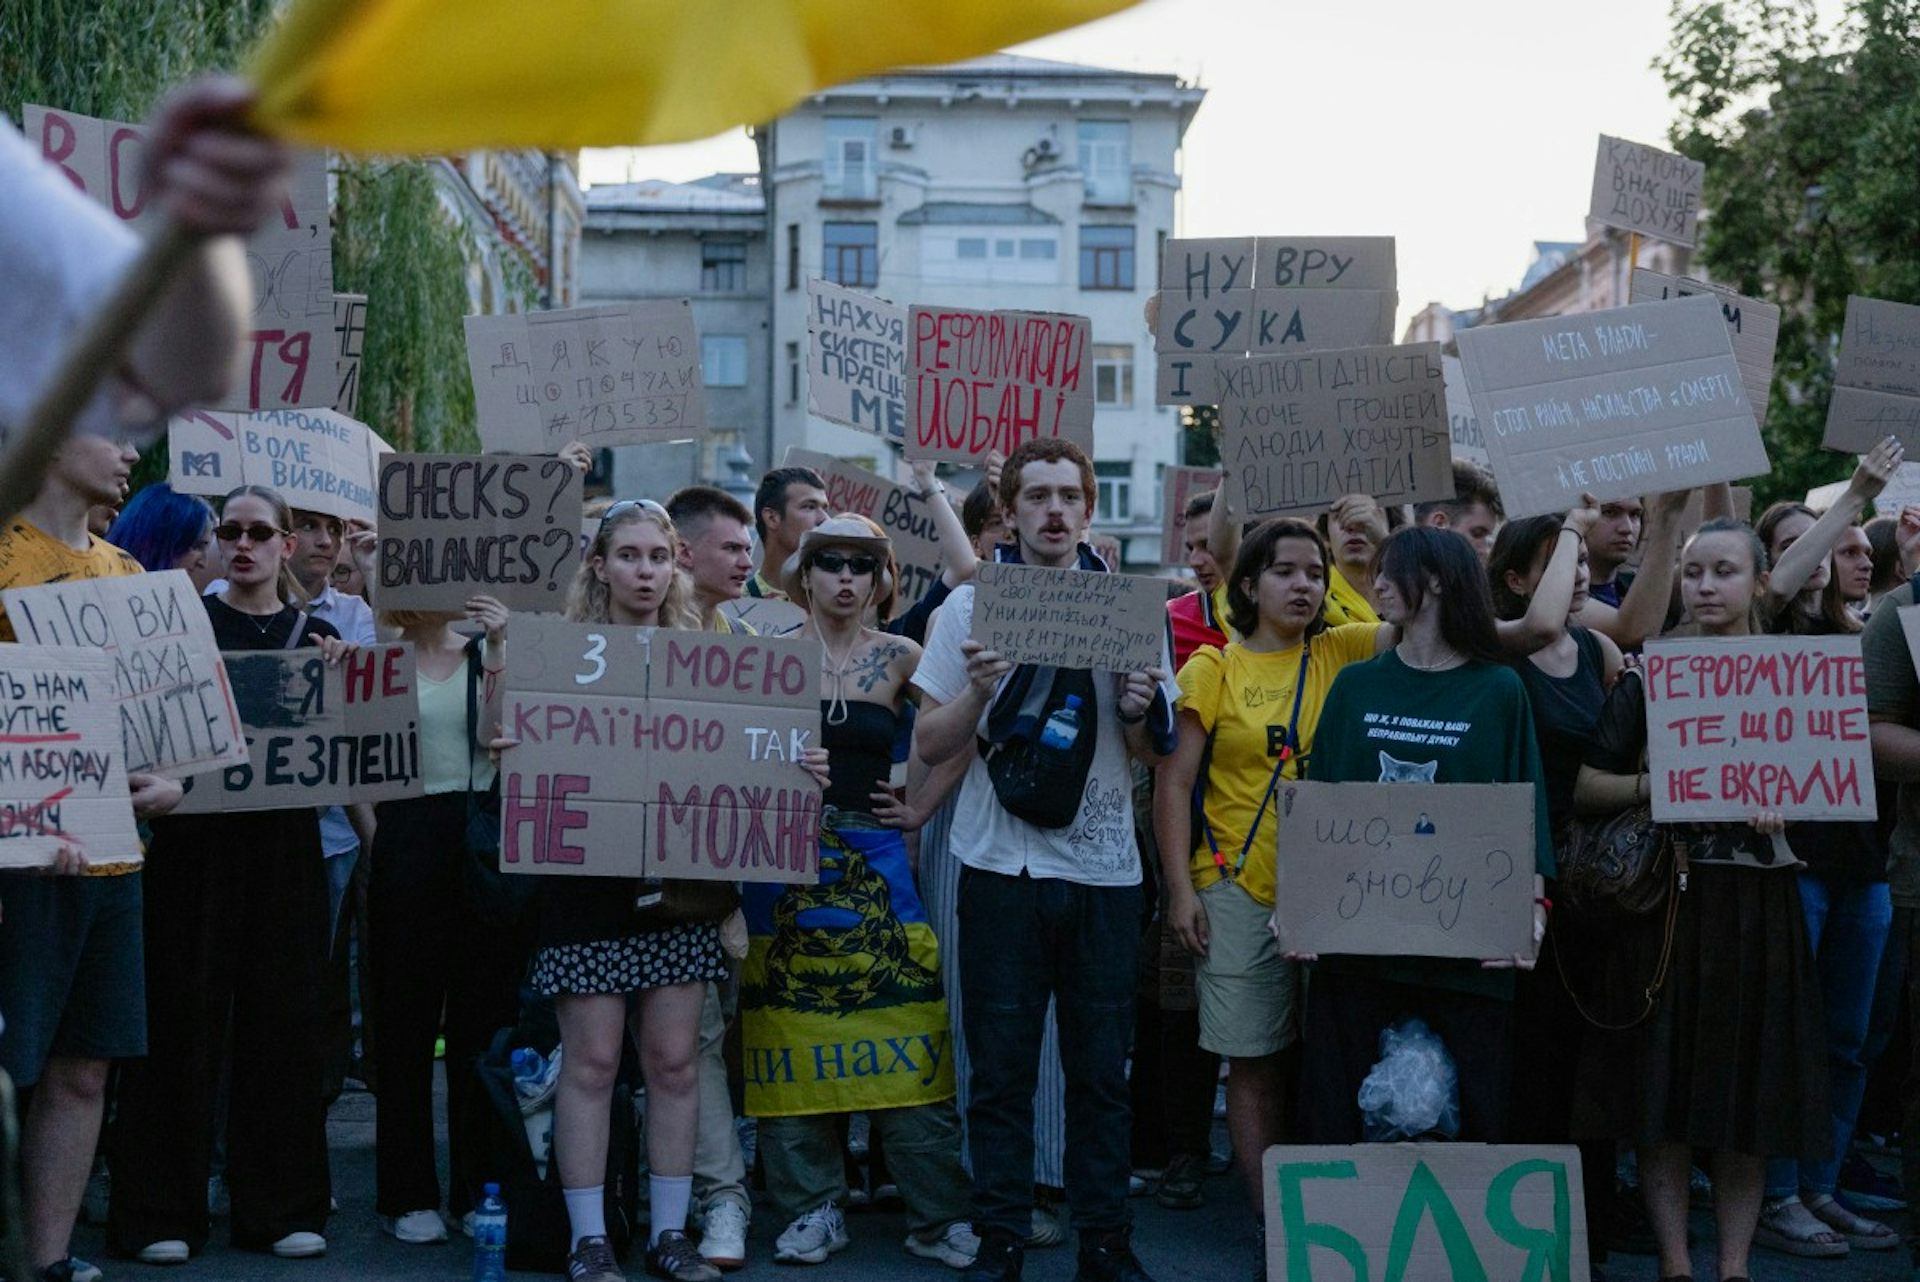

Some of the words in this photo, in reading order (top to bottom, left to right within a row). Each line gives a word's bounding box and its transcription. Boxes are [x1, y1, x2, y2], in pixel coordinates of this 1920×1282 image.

[1186, 251, 1245, 302] НУ
[1275, 247, 1354, 286] ВРУ
[816, 294, 904, 345] НАХУЯ
[1174, 308, 1306, 350] СУКА
[491, 335, 682, 377] ДЯКУЮ
[819, 330, 904, 370] СИСТЕМ
[916, 312, 1085, 392] РЕФОРМАТОРИ
[1542, 331, 1592, 362] МЕТА
[516, 381, 562, 406] ЩО
[851, 388, 905, 437] МЕ
[1239, 403, 1303, 429] ХОЧЕ
[1336, 389, 1440, 424] ГРОШЕЙ
[1236, 429, 1325, 462] ЛЮДИ
[1343, 425, 1443, 454] ХОЧУТЬ
[379, 460, 574, 524] CHECKS?
[1242, 452, 1417, 514] ВІДПЛАТИ!
[381, 528, 574, 592] BALANCES?
[128, 586, 189, 638] ВИ
[34, 671, 89, 702] НАМ
[110, 642, 195, 698] ЛЯХА
[345, 646, 408, 704] НЕ
[666, 639, 806, 695] МОЄЮ
[1647, 650, 1868, 702] РЕФОРМУЙТЕ
[514, 702, 725, 752] КРАЇНОЮ
[744, 727, 811, 763] ТАК
[1740, 706, 1794, 744] ЩО
[1807, 707, 1867, 742] ЩЕ
[21, 747, 110, 792] АБСУРДУ
[1667, 767, 1713, 804] НЕ
[1721, 757, 1862, 808] ВКРАЛИ
[504, 772, 591, 866] НЕ
[656, 781, 821, 874] МОЖНА
